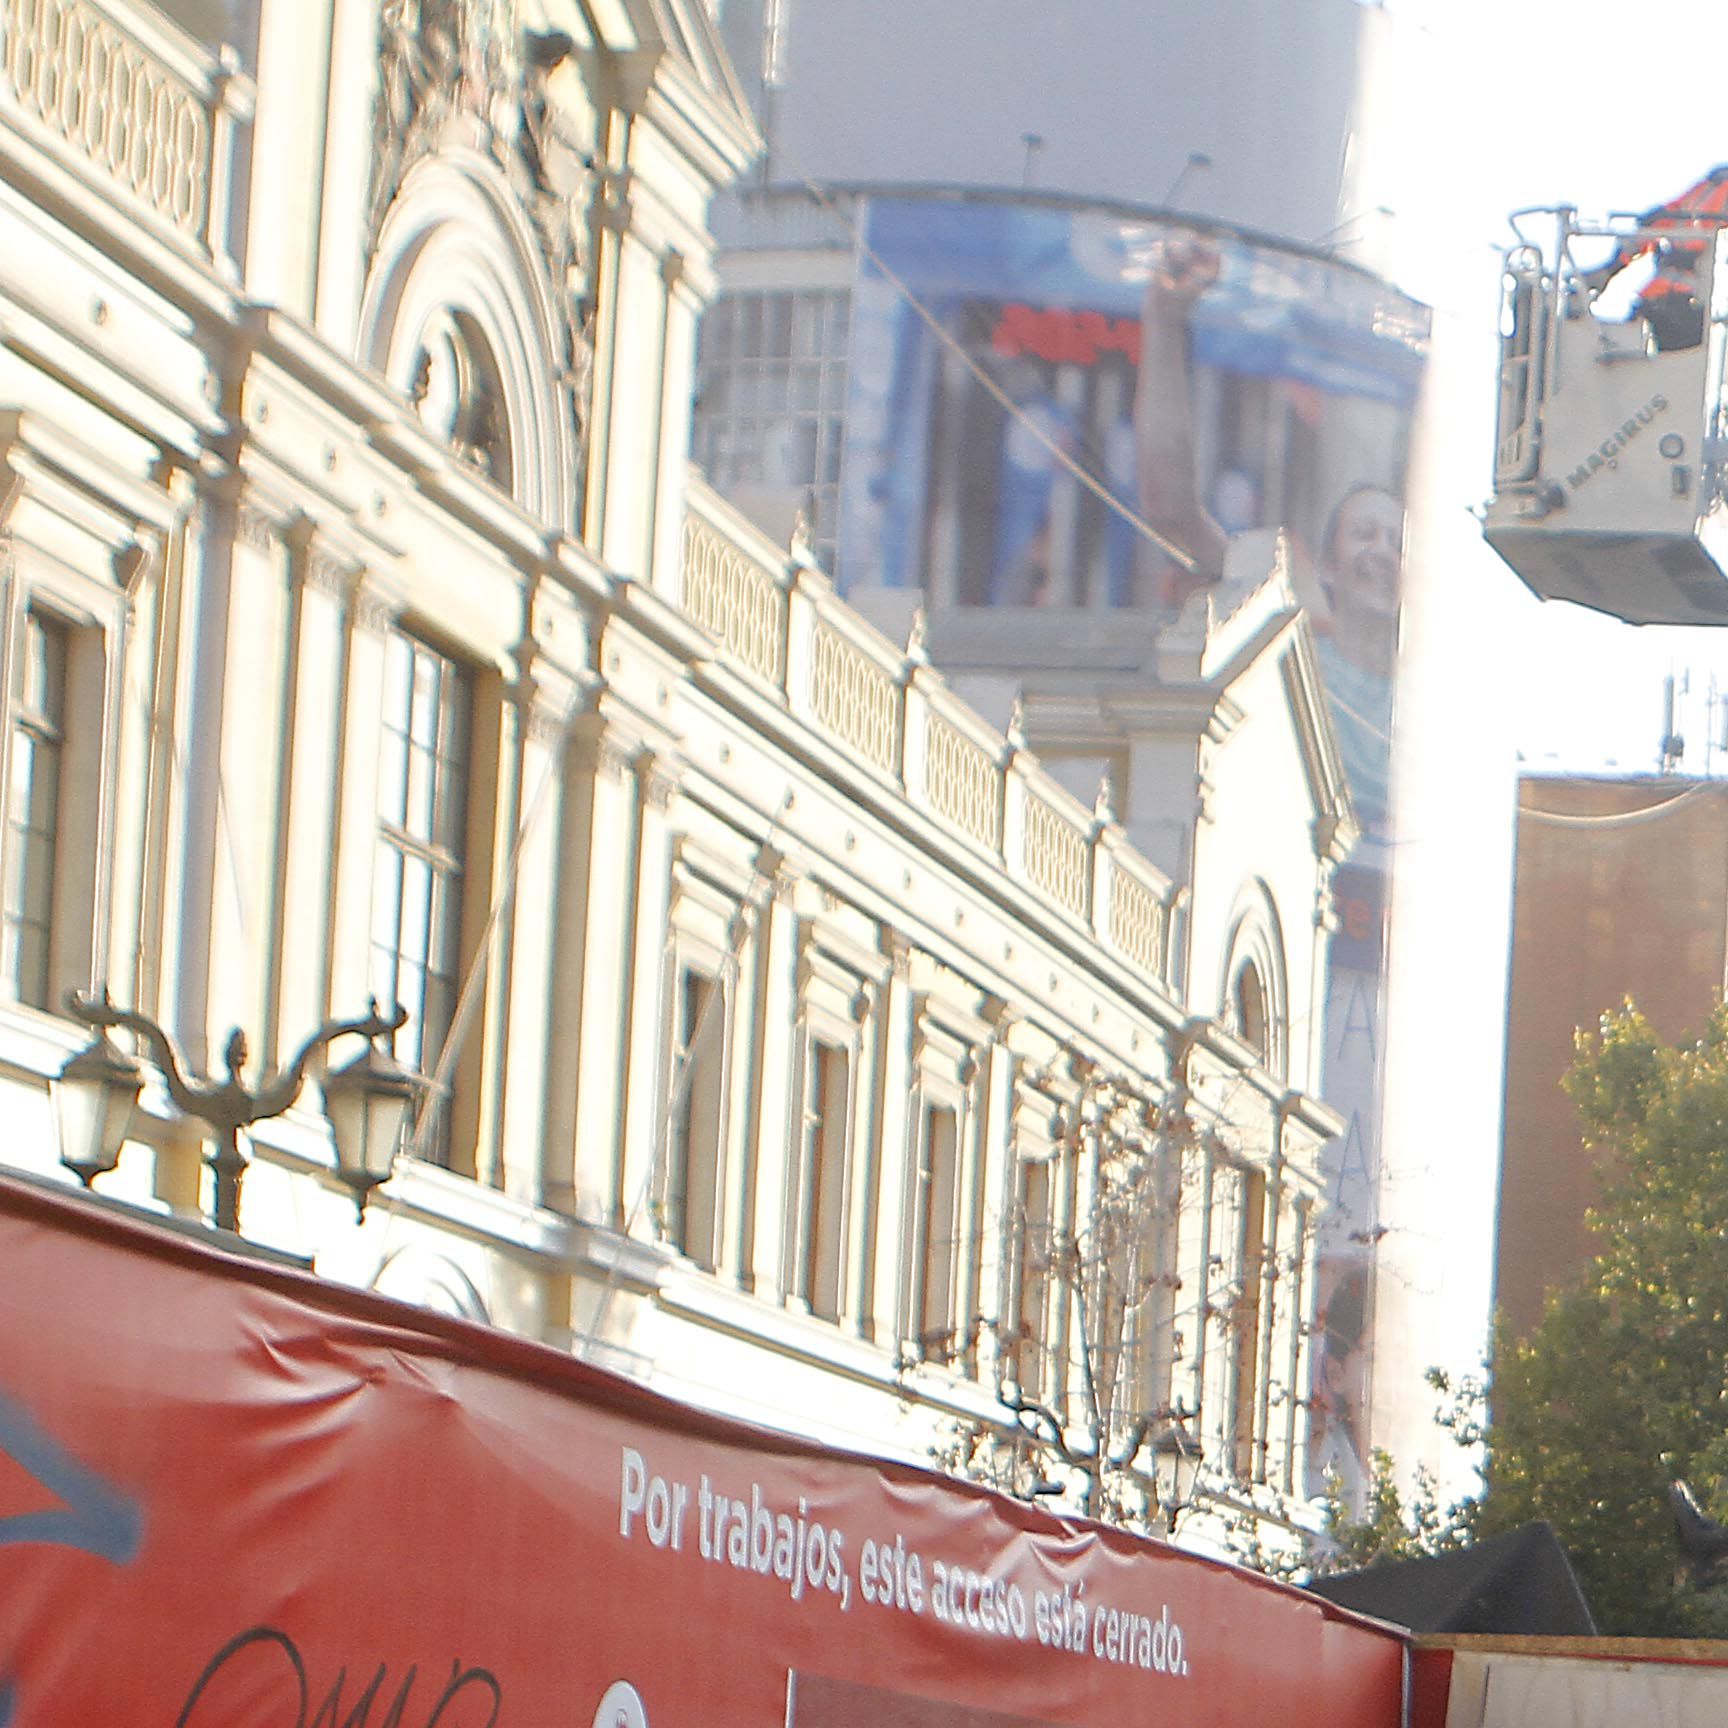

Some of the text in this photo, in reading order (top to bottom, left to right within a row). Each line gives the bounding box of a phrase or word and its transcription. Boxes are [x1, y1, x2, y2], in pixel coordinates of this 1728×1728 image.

[1566, 394, 1668, 489] MAGIRUS
[619, 1446, 1188, 1676] Por trabajos, este acceso está cerrado.
